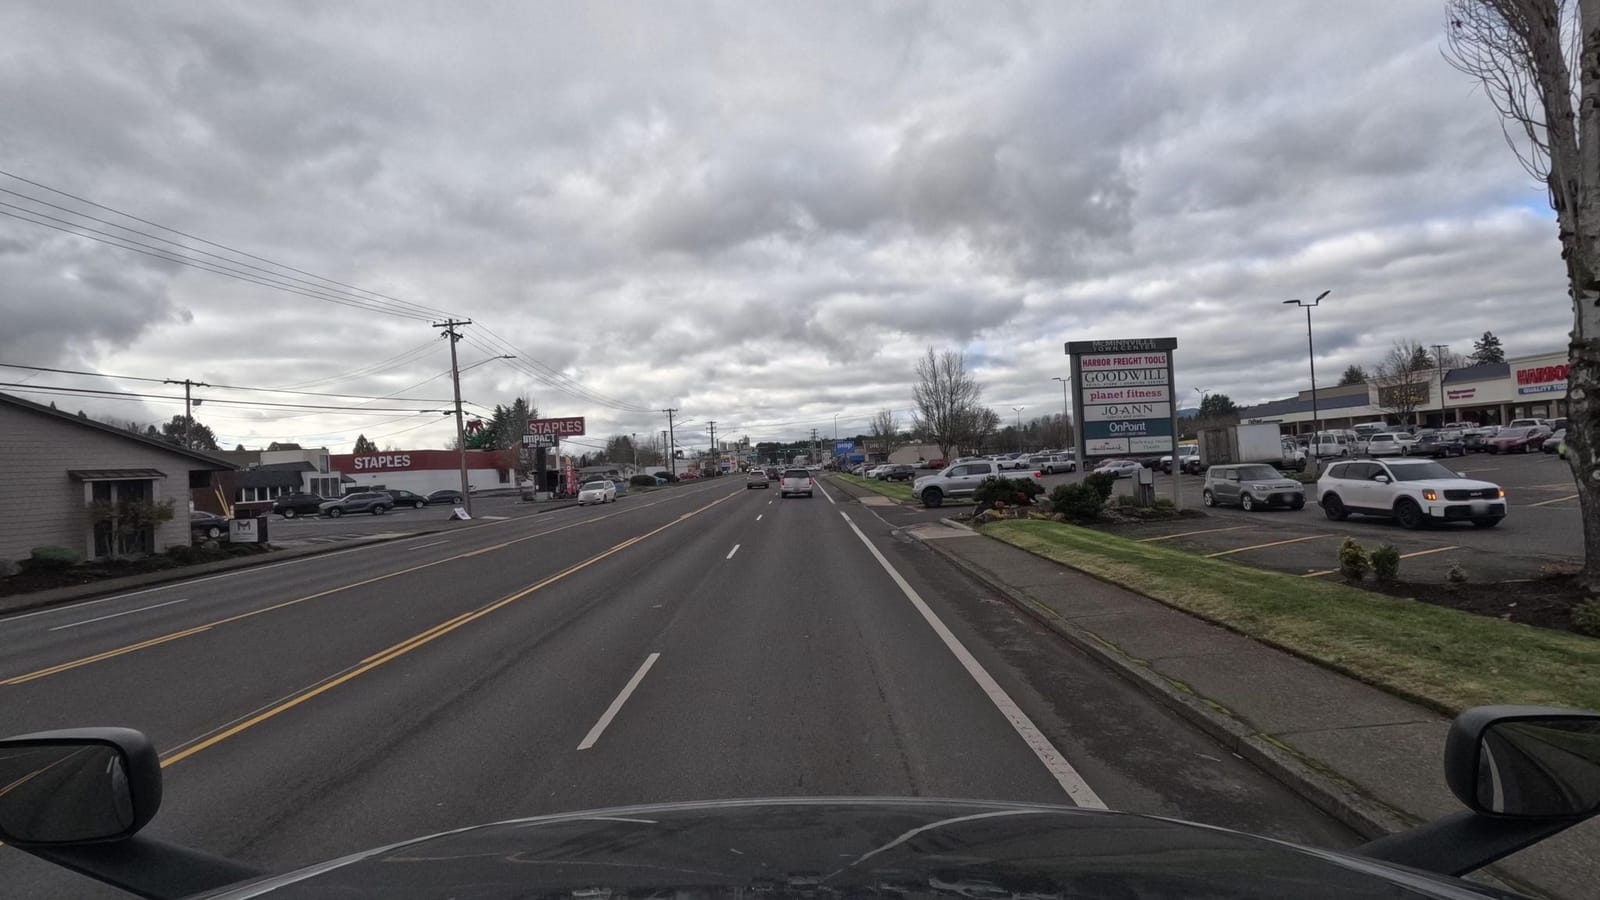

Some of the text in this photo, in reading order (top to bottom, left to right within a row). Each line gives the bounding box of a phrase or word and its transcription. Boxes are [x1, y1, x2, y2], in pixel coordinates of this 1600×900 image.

[1082, 356, 1166, 367] HARBOR FREIGHT TOOLS
[1084, 370, 1165, 382] GOODWILL
[1517, 365, 1569, 384] HARBO
[1090, 388, 1162, 402] planet fitness
[529, 421, 582, 434] STAPLES
[1109, 422, 1147, 432] OnPoint
[354, 455, 411, 470] STAPLES
